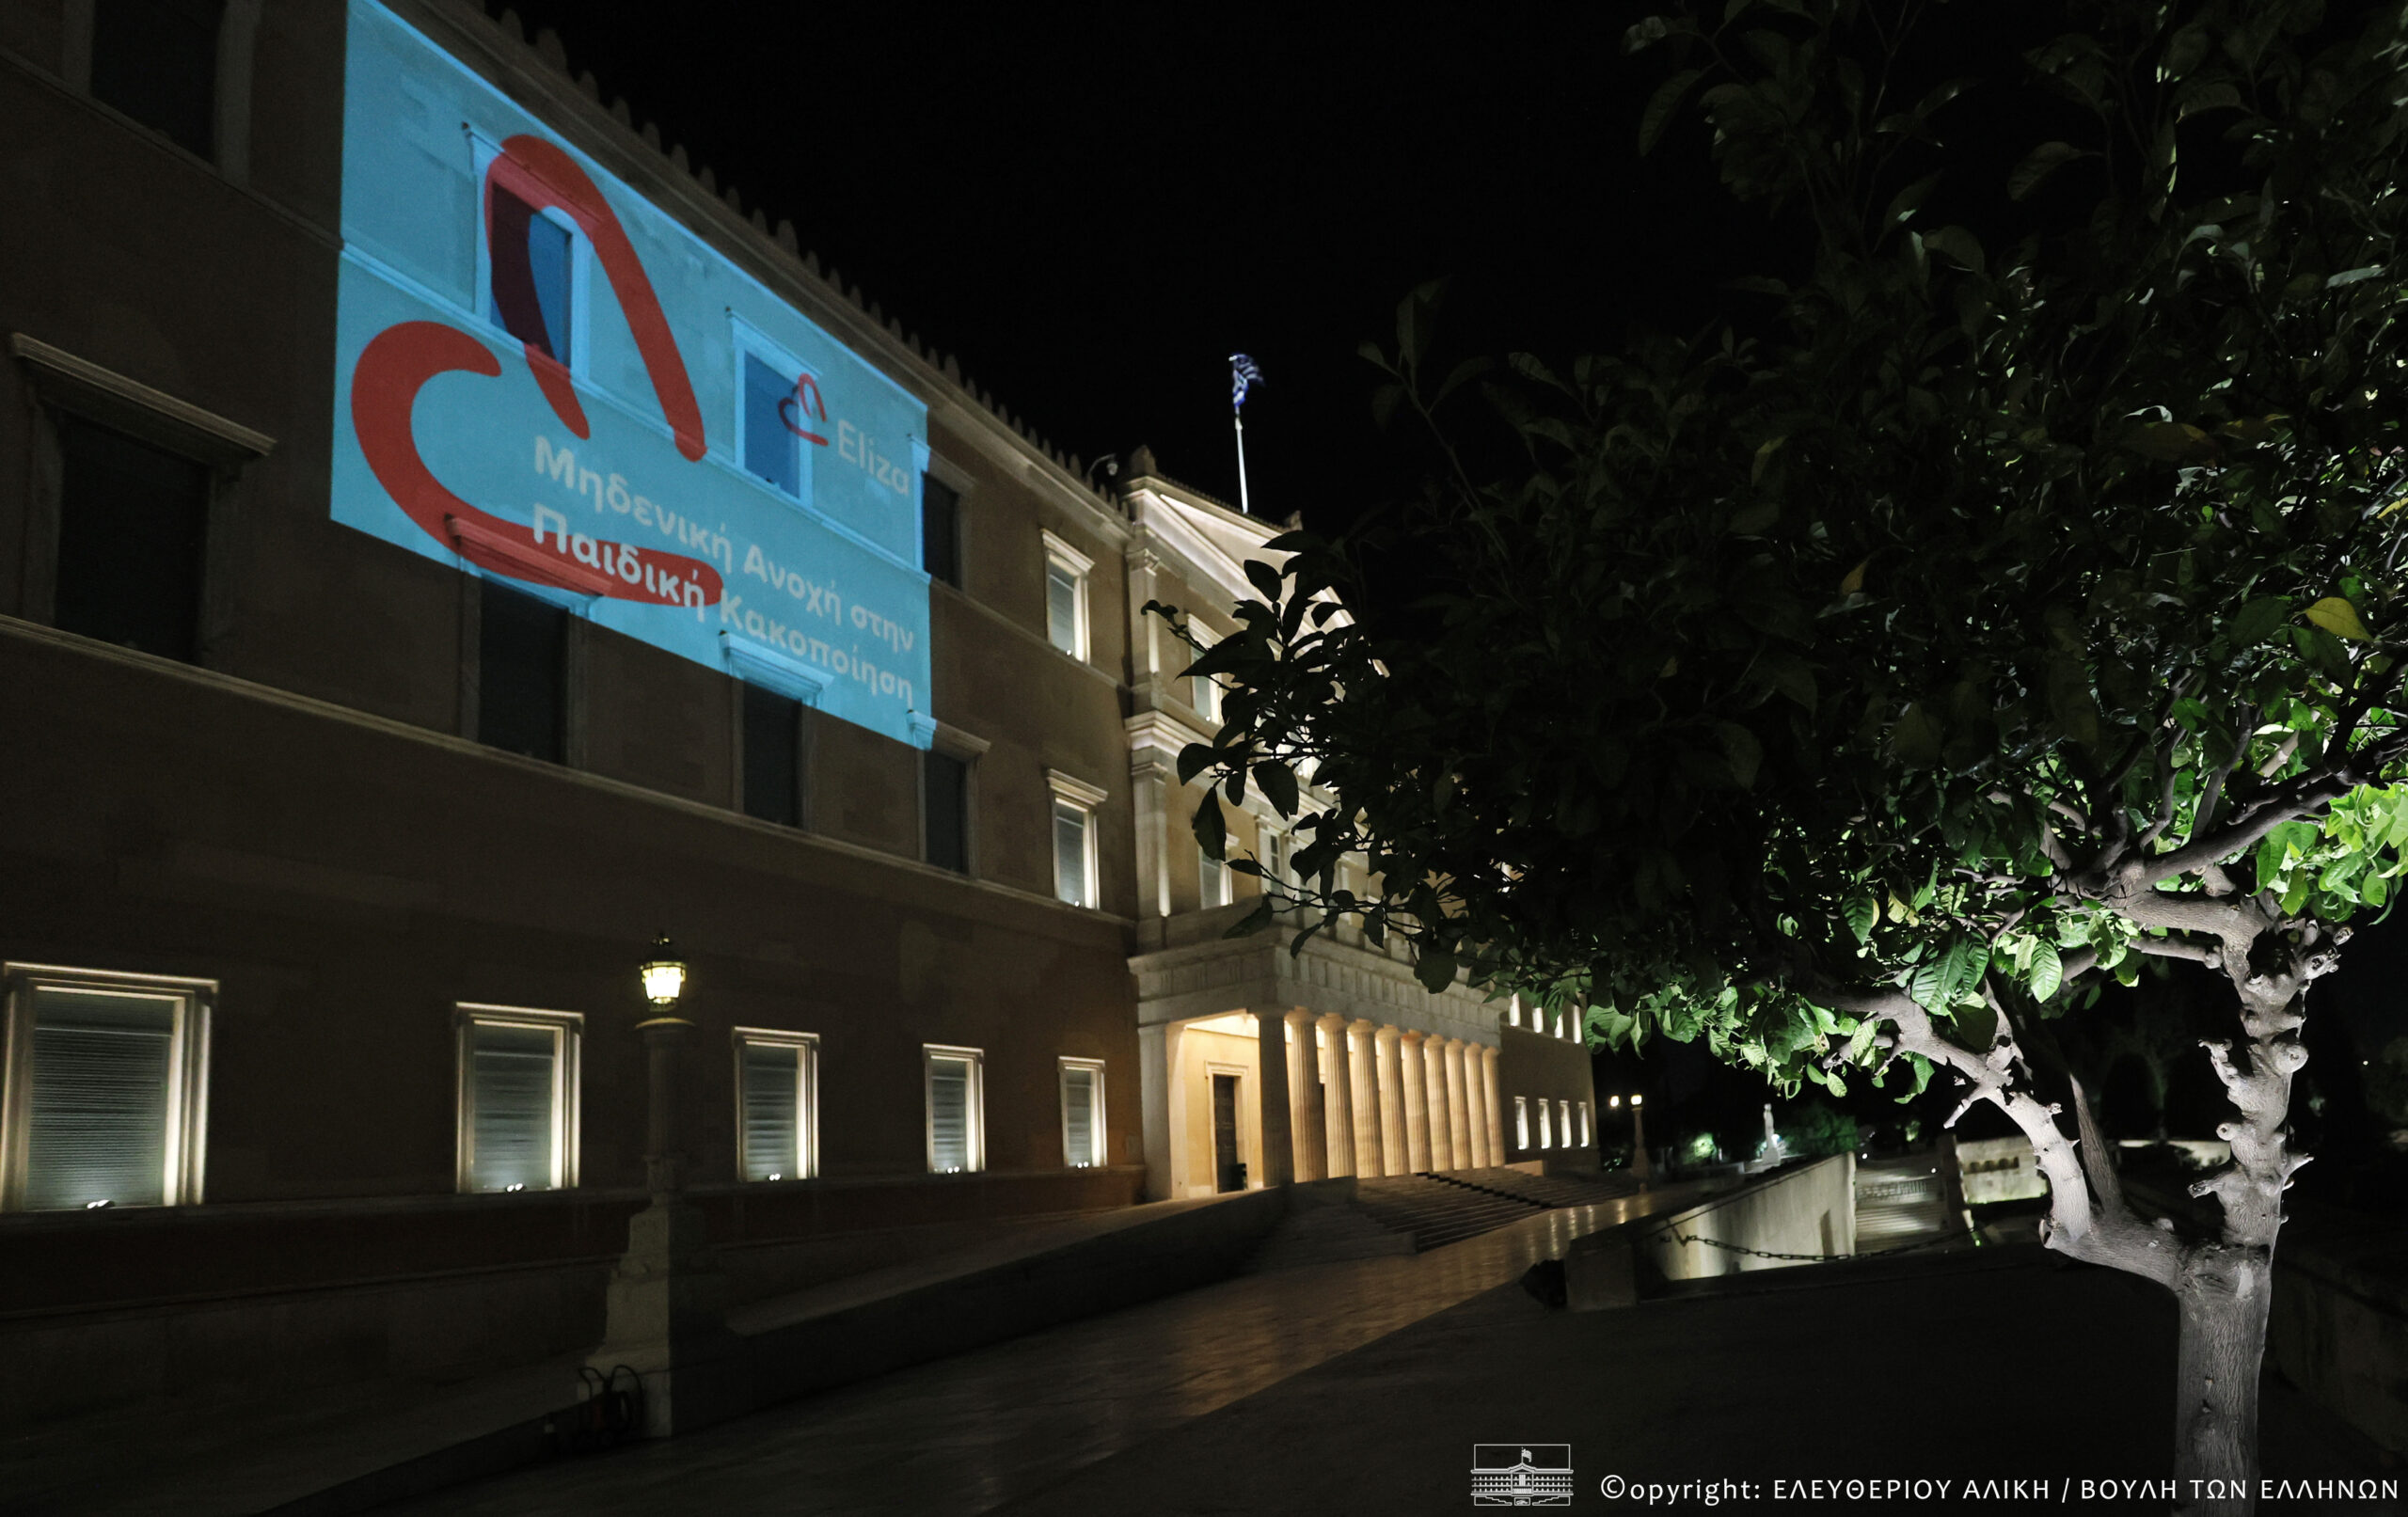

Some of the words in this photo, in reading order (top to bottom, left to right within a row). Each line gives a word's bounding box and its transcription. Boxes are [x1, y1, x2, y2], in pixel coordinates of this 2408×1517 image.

[534, 436, 732, 573] Μηδενική
[744, 545, 841, 625] Ανοχή
[851, 605, 915, 653] στην
[837, 421, 910, 496] Eliza
[533, 504, 705, 622] Παιδική
[721, 589, 912, 707] Κακοποίηση
